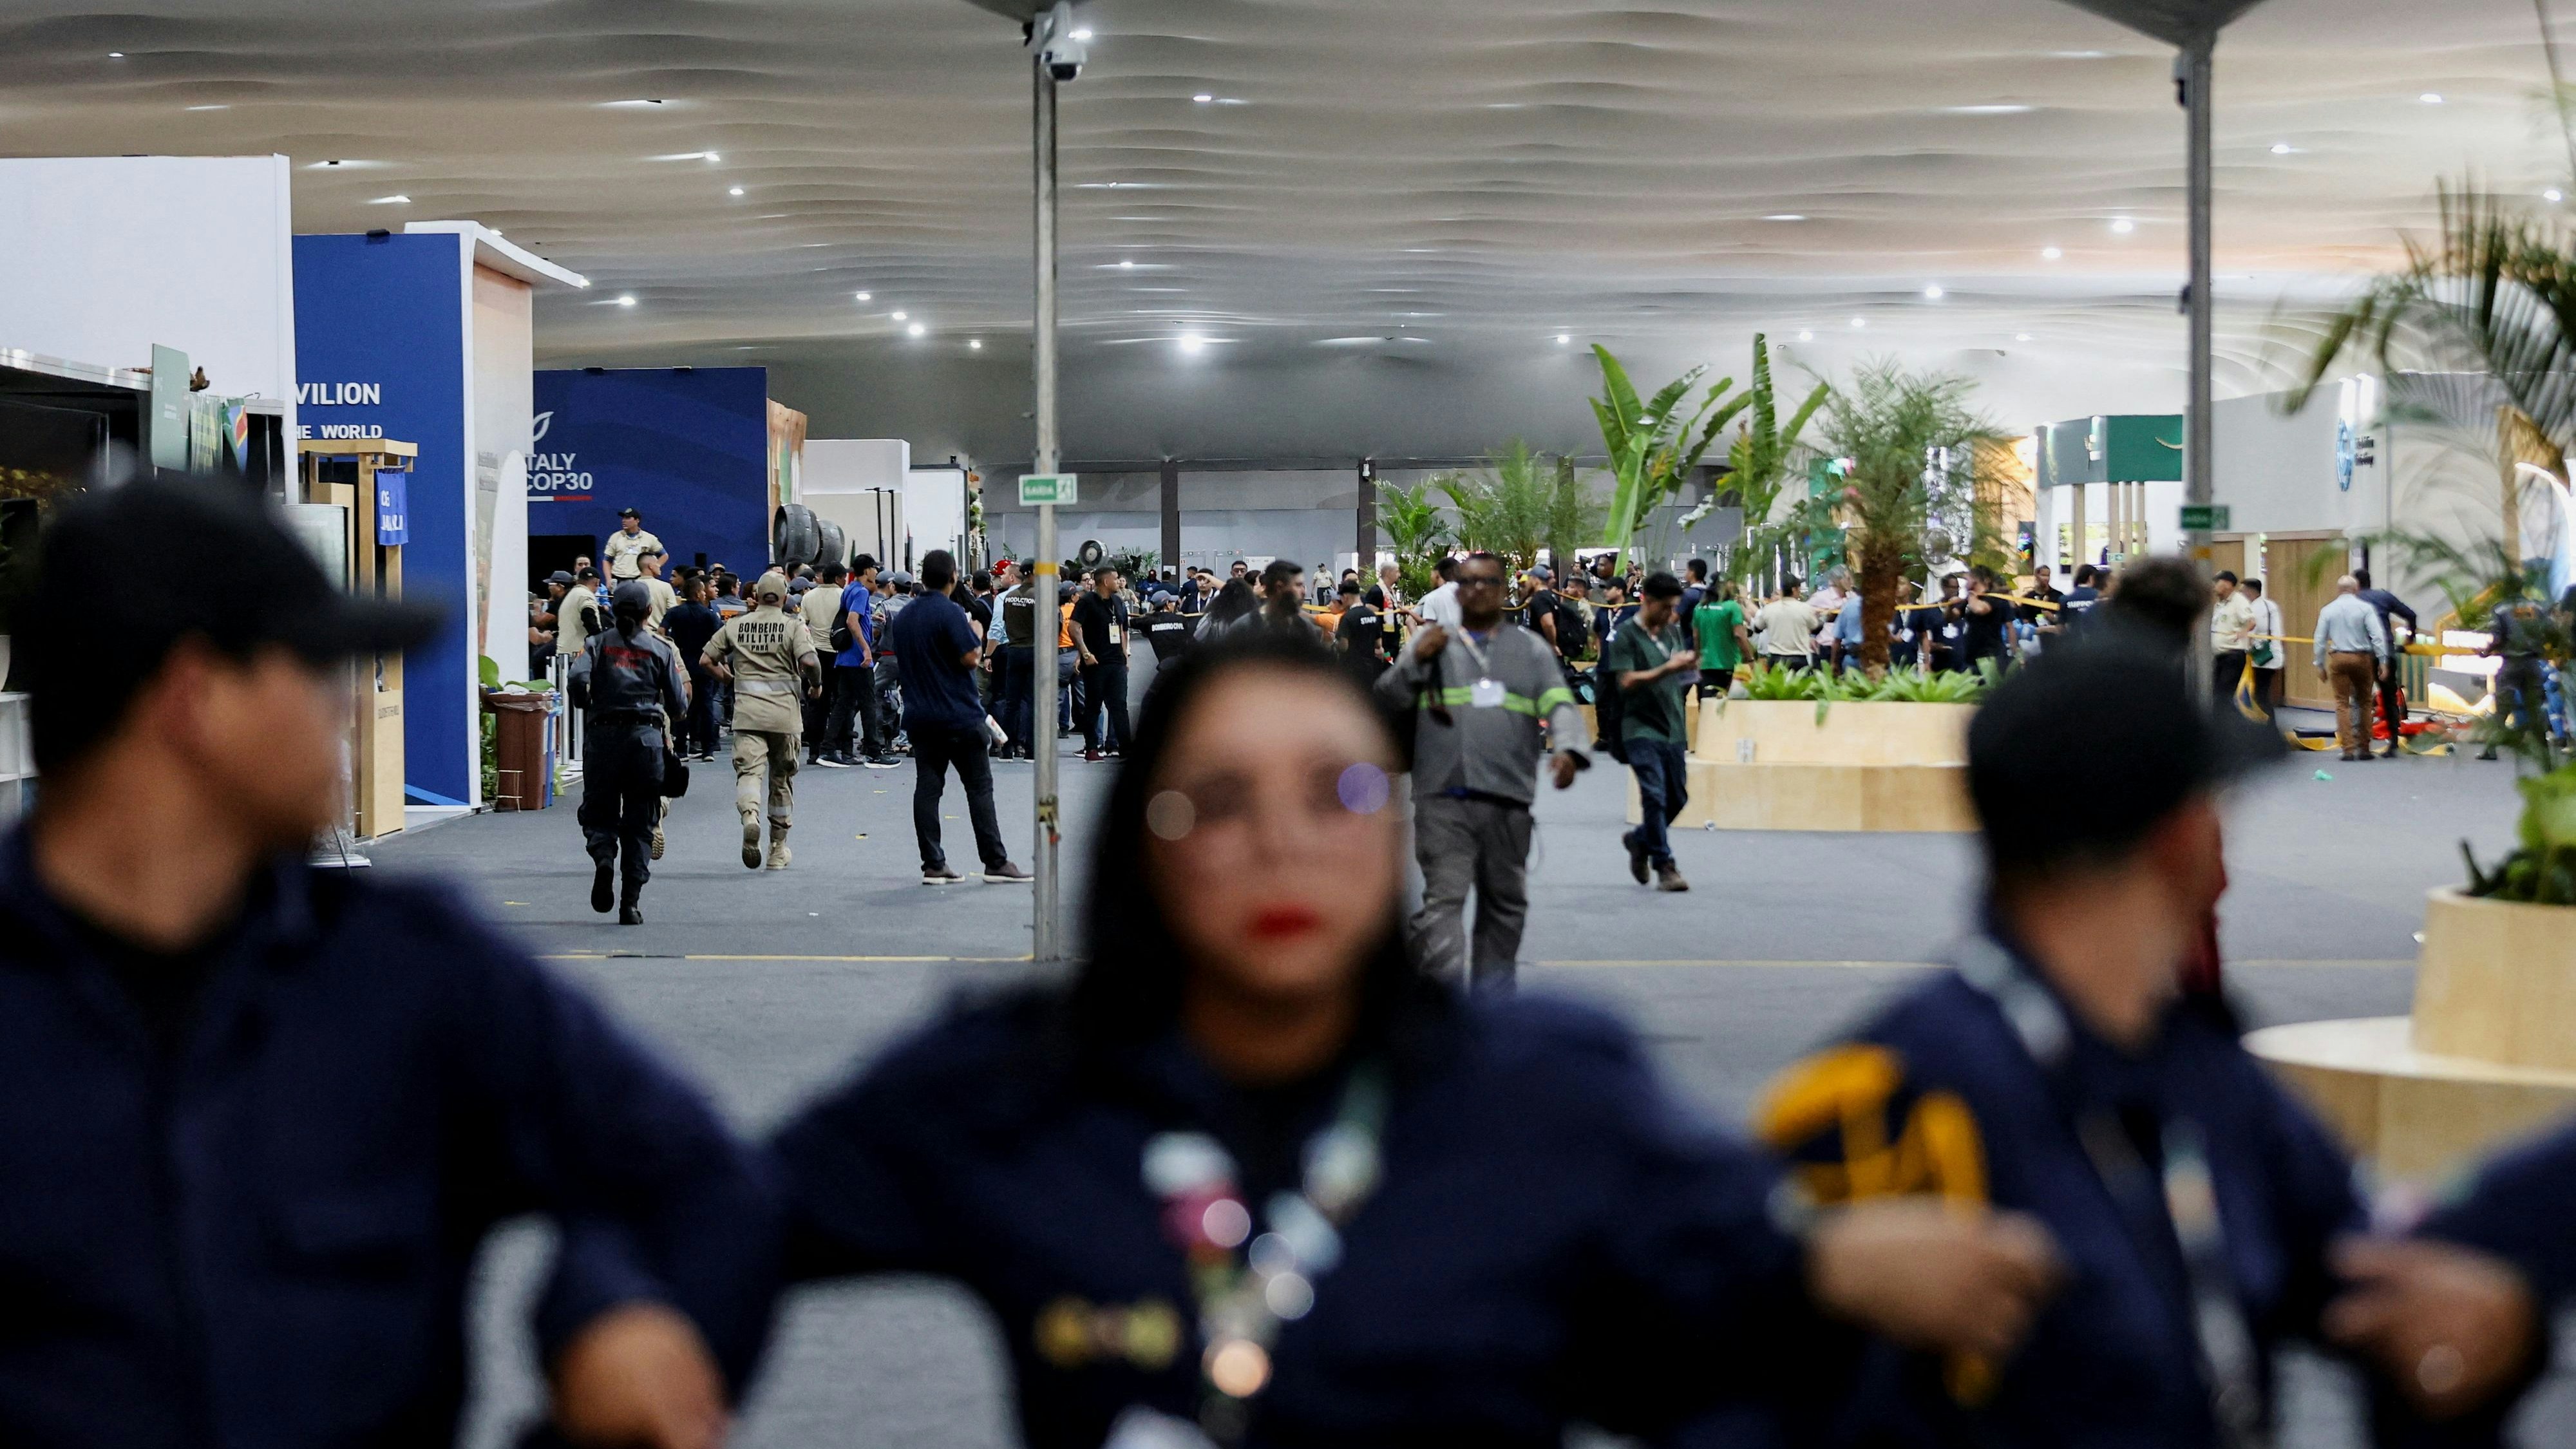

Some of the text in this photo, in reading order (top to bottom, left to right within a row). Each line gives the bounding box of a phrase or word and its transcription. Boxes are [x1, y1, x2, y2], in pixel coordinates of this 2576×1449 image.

[321, 424, 383, 439] WORLD
[739, 623, 784, 633] BOMBEIRO
[737, 634, 783, 643] MILITAR
